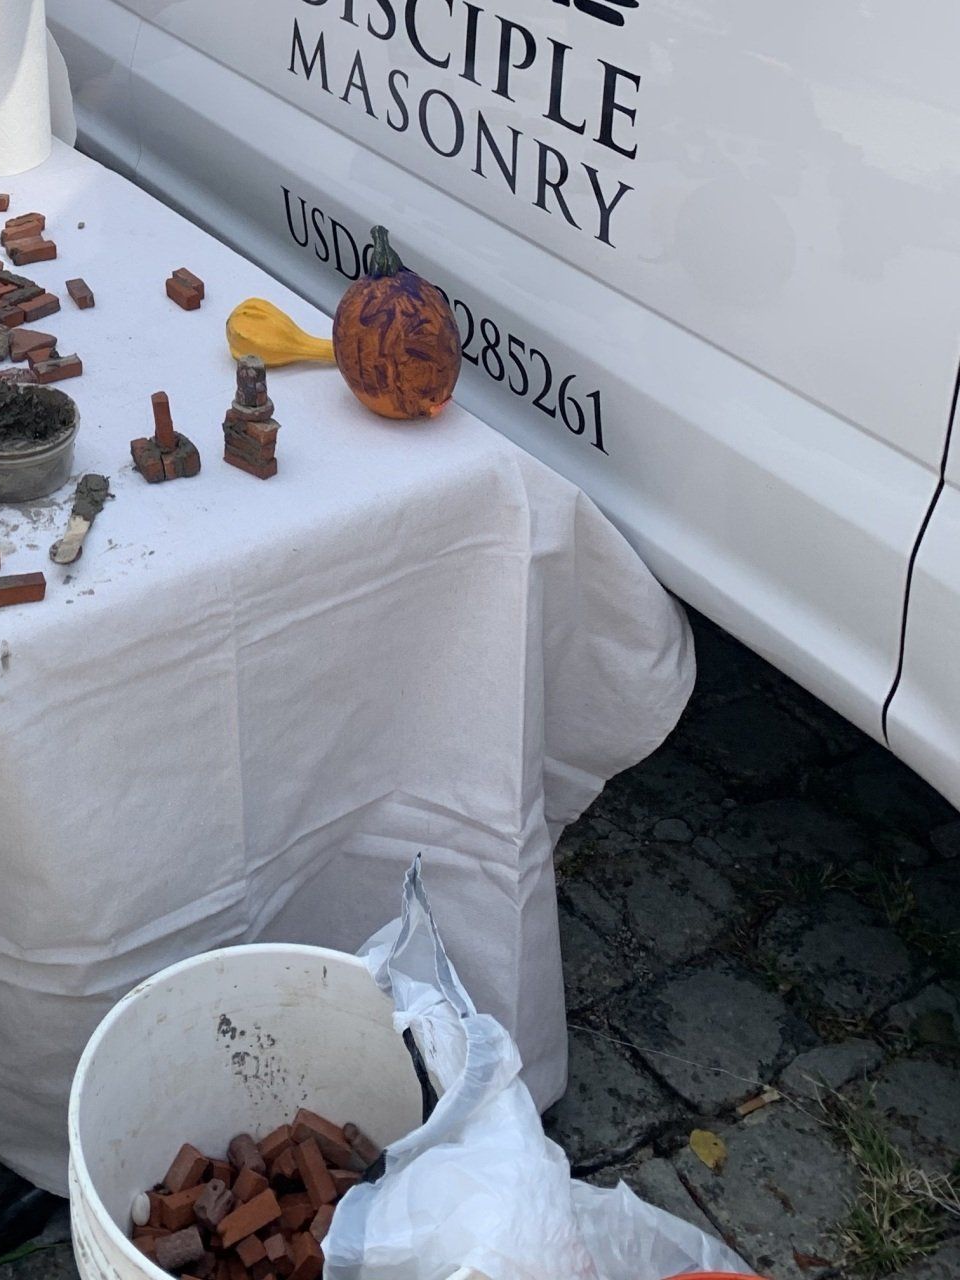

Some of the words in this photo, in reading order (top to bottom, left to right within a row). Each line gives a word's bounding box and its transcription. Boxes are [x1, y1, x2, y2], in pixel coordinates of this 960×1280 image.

[288, 17, 635, 249] MASONRY
[280, 185, 417, 281] USD
[434, 285, 610, 457] 285261
